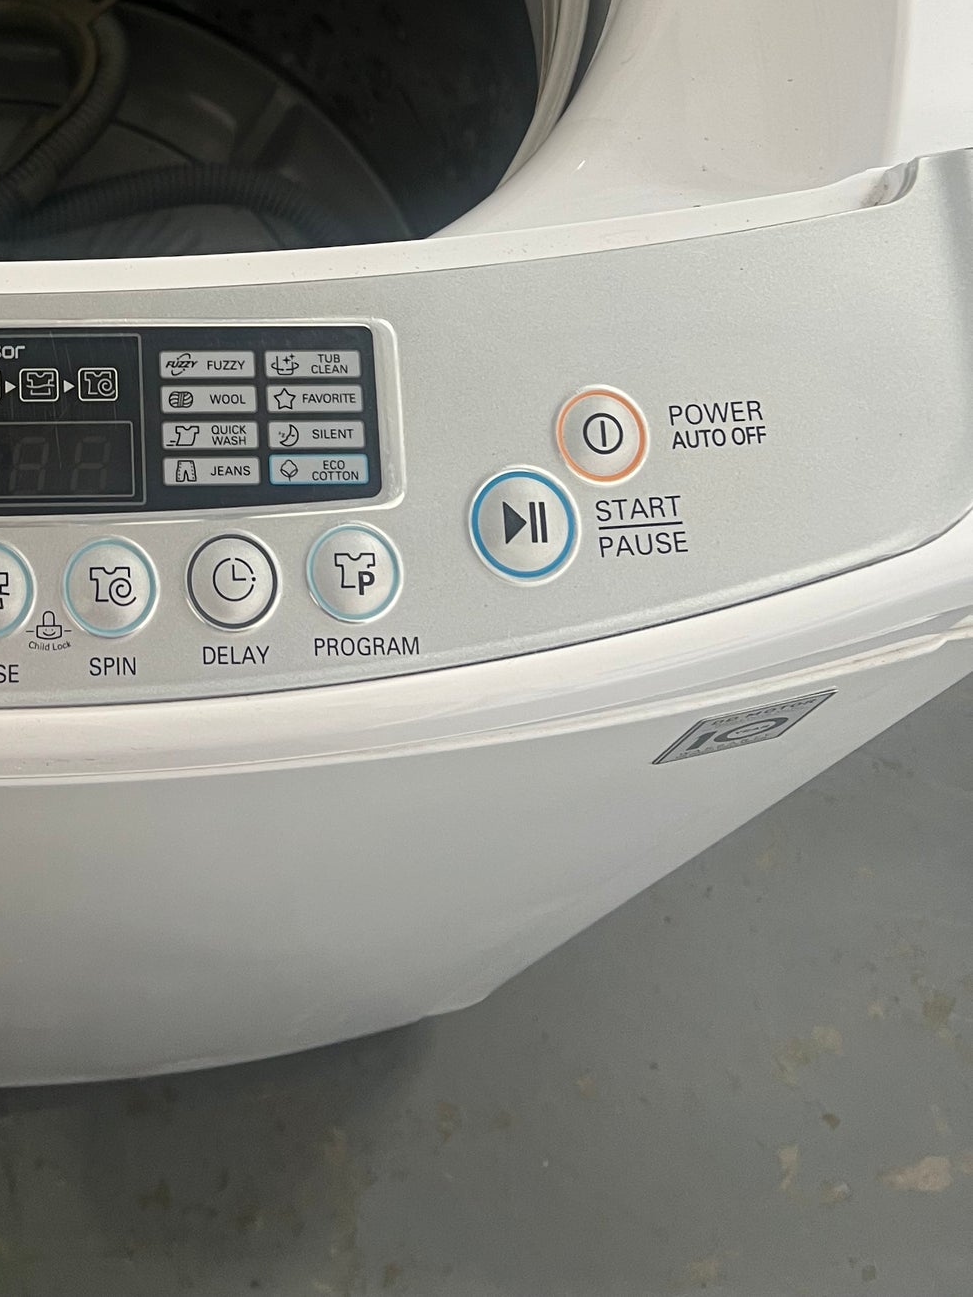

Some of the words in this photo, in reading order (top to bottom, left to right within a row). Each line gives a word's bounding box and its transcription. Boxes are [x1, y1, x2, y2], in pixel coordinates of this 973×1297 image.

[317, 354, 341, 363] TUB
[207, 360, 246, 371] FUZZY
[311, 364, 348, 374] CLEAN
[209, 394, 246, 405] WOOL
[302, 393, 356, 404] FAVORITE
[668, 400, 764, 426] POWER
[211, 425, 247, 435] QUICK
[312, 429, 354, 439] SILENT
[211, 436, 247, 446] WASH
[671, 429, 726, 450] AUTO
[731, 425, 767, 446] OFF
[322, 459, 345, 470] ECO
[210, 465, 251, 477] JEANS
[312, 470, 359, 481] COTTON
[595, 495, 682, 522] START
[598, 531, 689, 558] PAUSE
[28, 640, 51, 651] Child
[52, 640, 71, 651] Lock
[314, 636, 420, 657] PROGRAM
[202, 645, 270, 665] DELAY
[89, 656, 137, 676] SPIN
